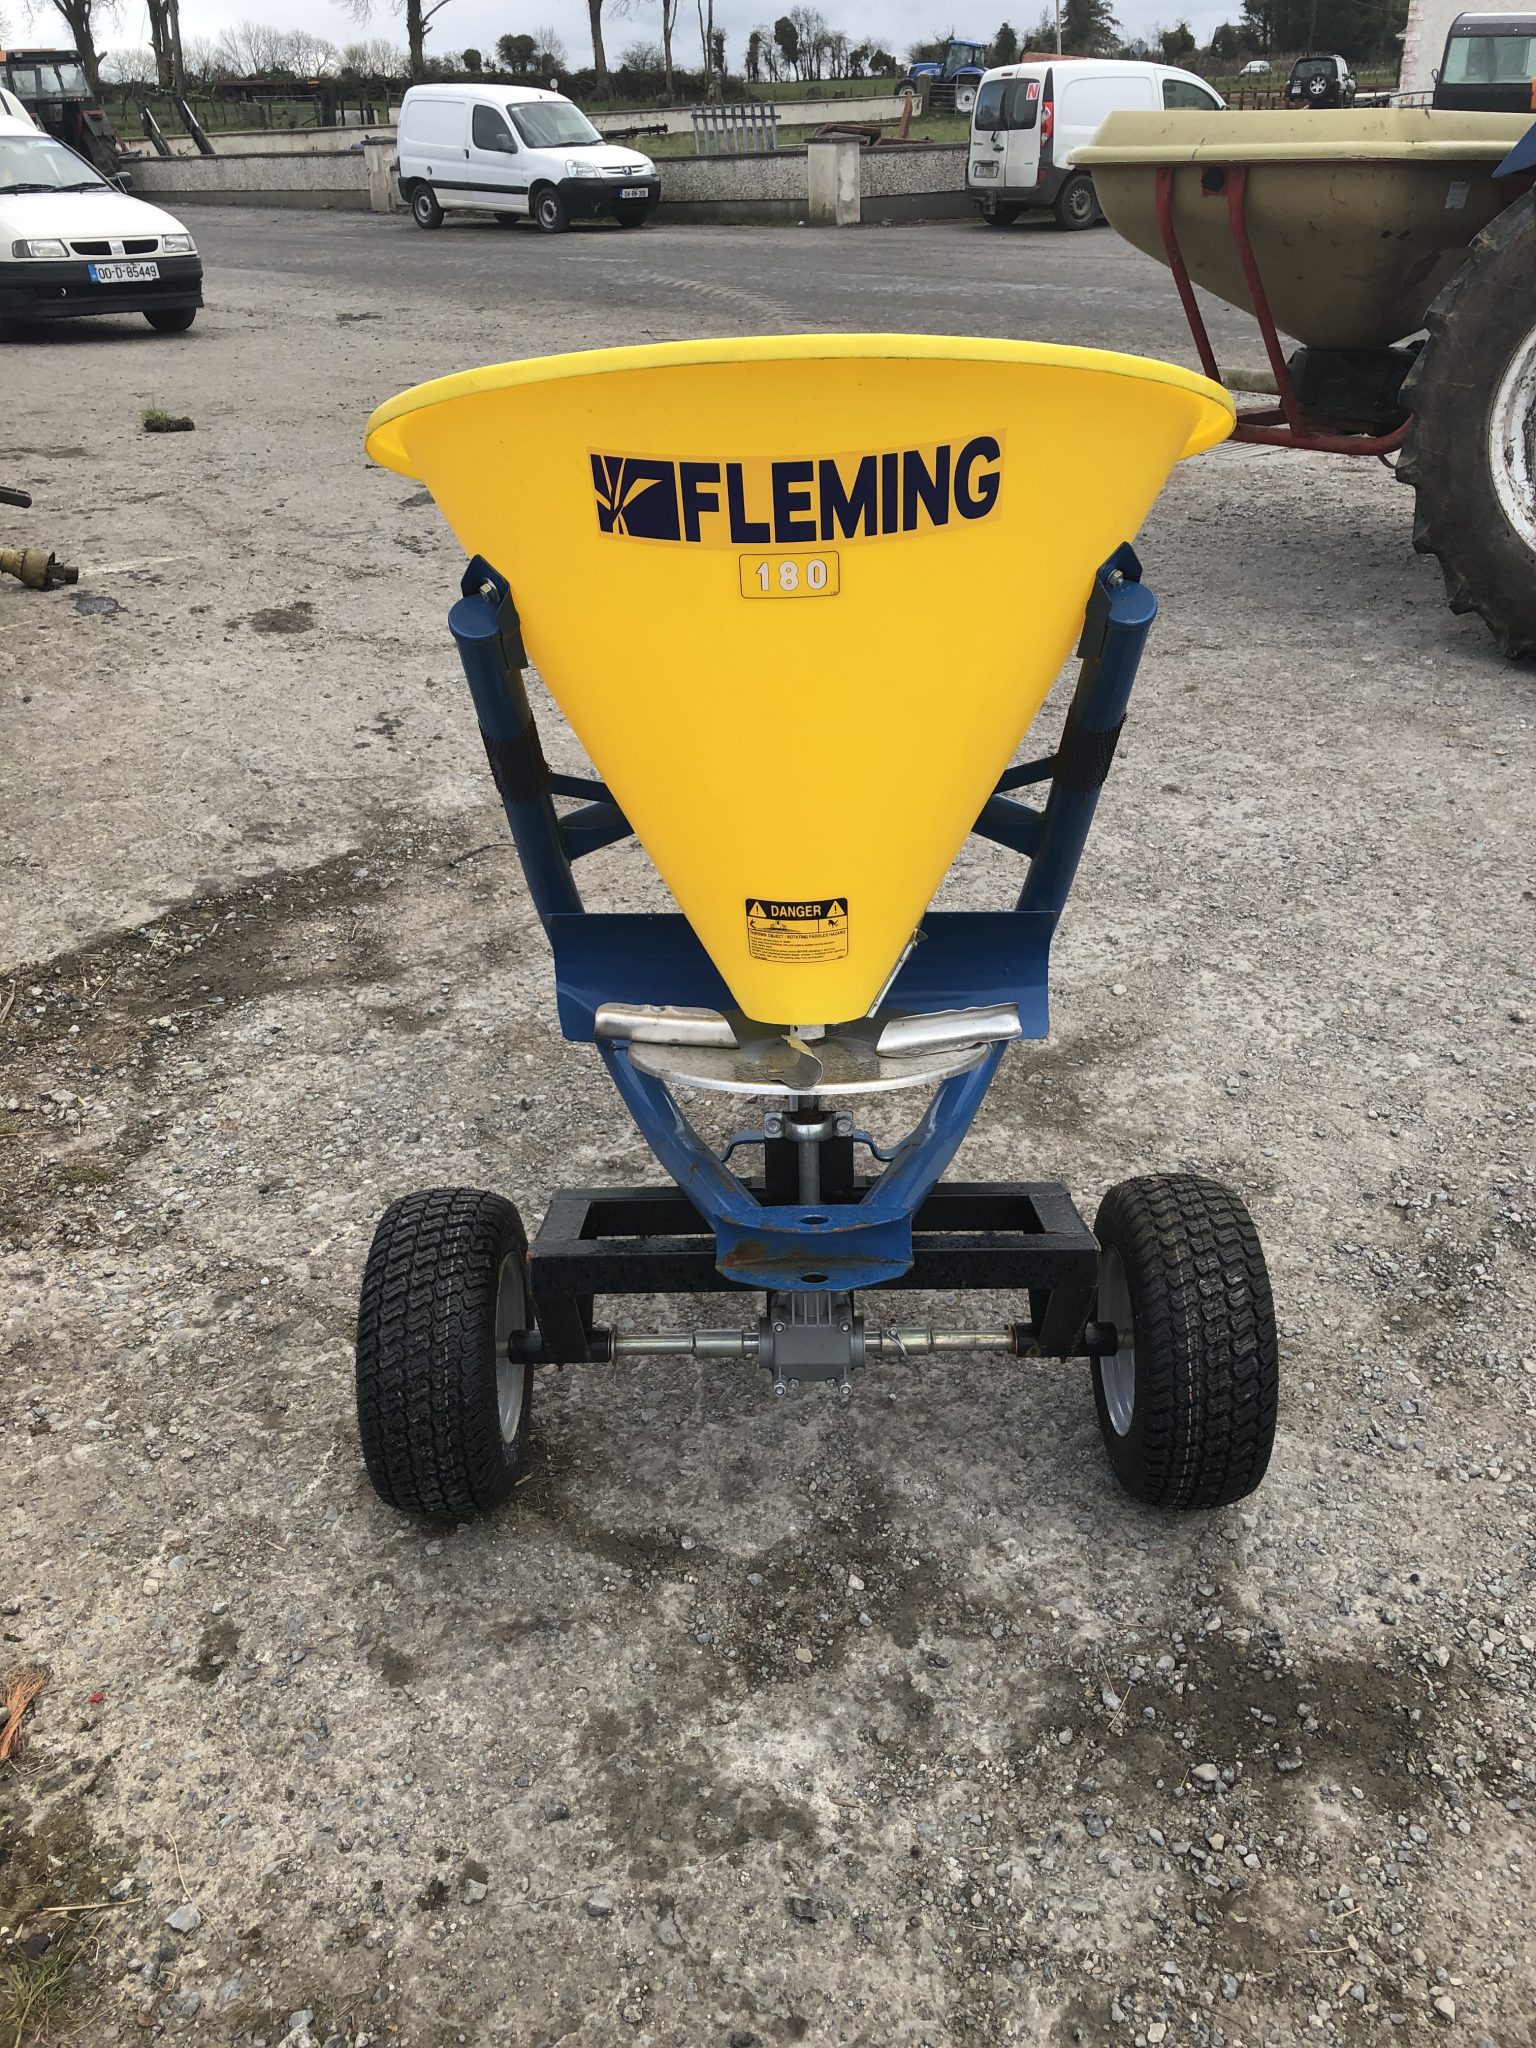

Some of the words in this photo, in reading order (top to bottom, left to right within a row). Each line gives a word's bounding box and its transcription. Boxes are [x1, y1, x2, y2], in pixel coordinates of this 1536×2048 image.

[1027, 84, 1039, 99] N
[98, 266, 157, 279] 00-D-85449
[680, 436, 1001, 543] FLEMING
[756, 559, 828, 592] 180
[771, 905, 821, 917] DANGER
